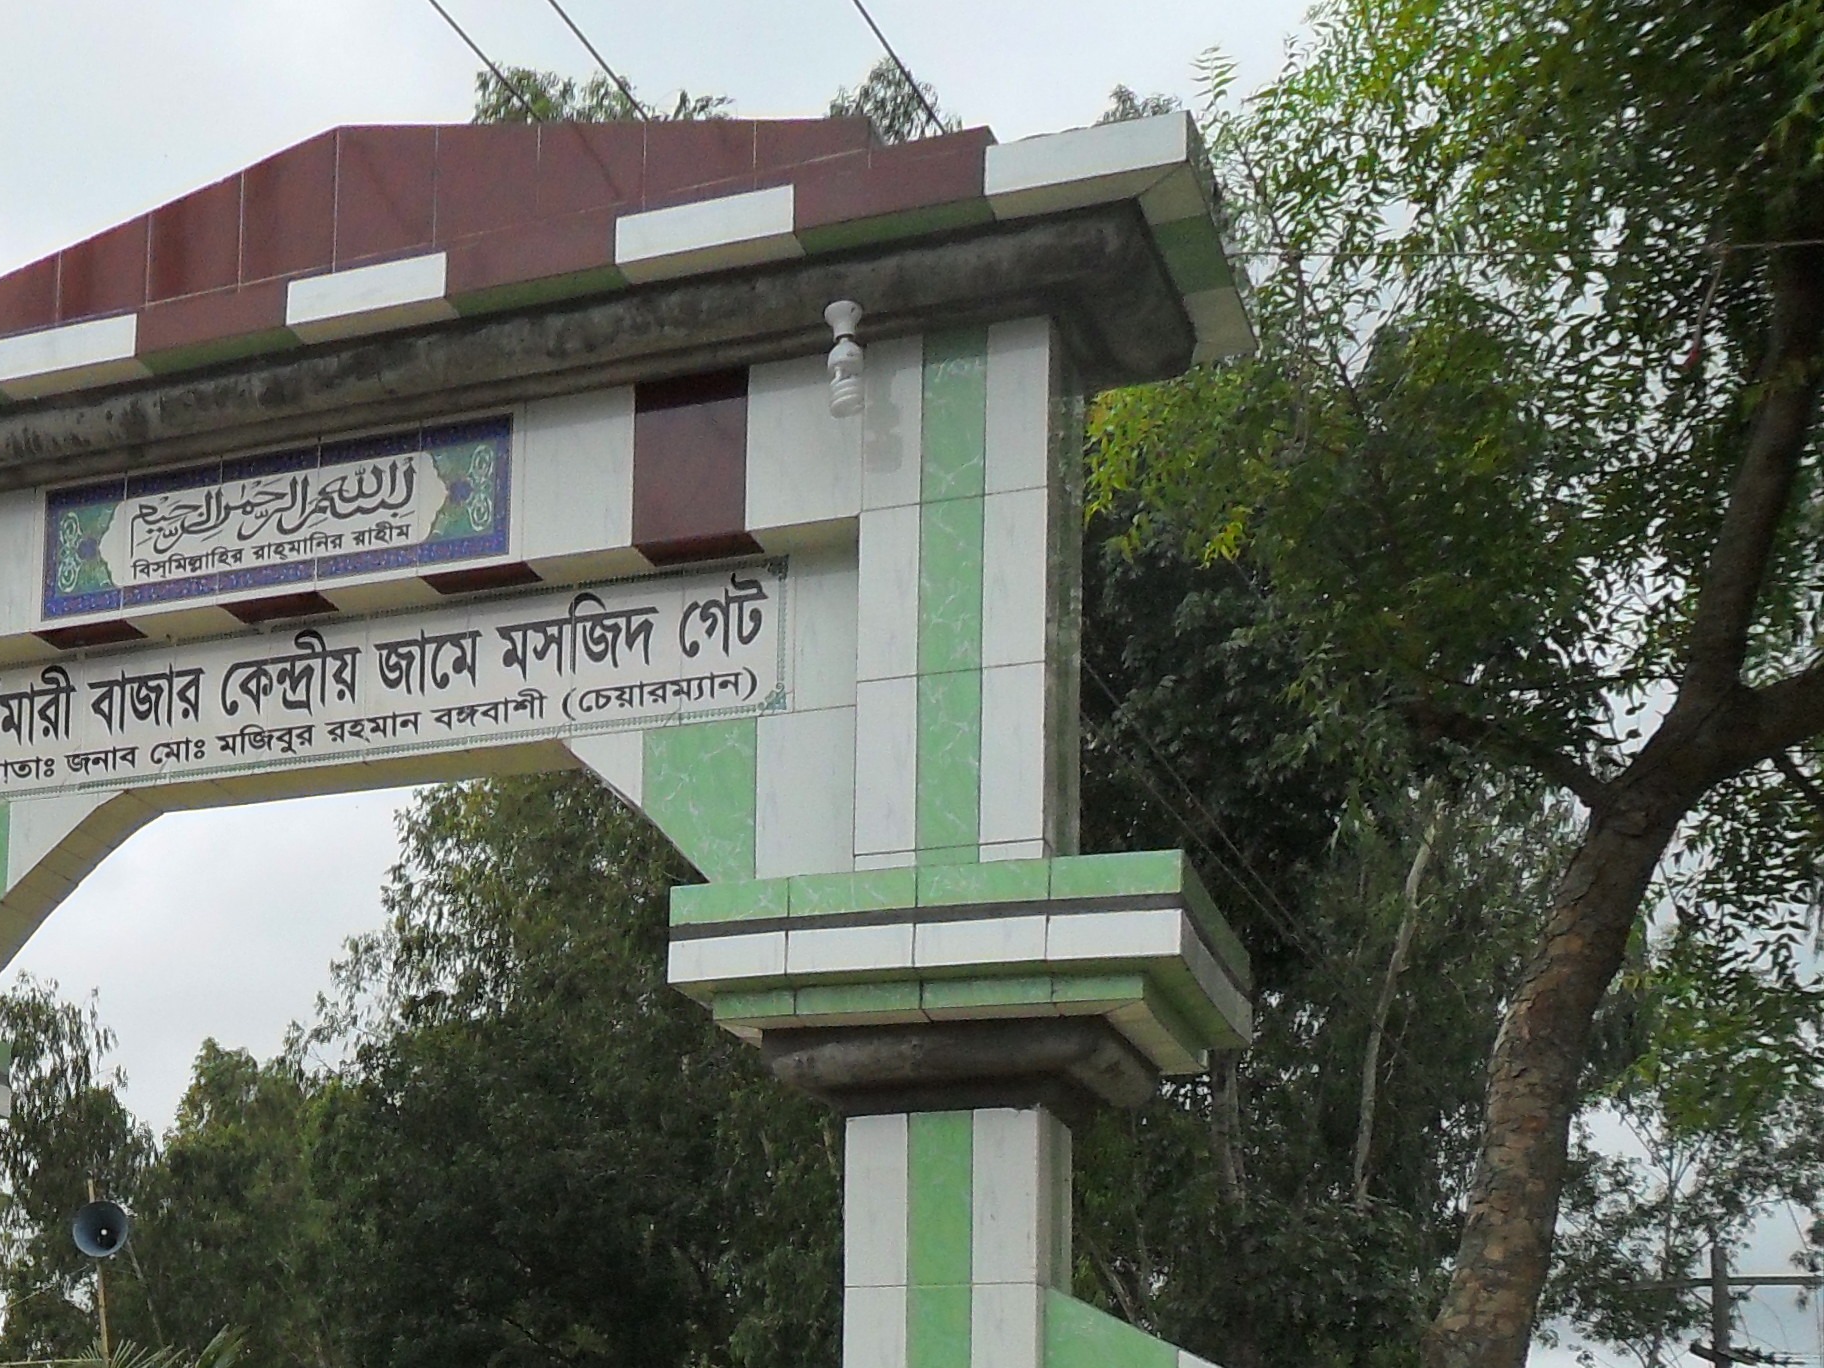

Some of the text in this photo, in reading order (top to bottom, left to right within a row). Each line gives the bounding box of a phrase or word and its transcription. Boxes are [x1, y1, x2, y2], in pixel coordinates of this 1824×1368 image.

[351, 520, 411, 546] রাহীম
[88, 663, 203, 737] বাজার
[222, 629, 362, 717] কেন্দ্রীয়
[374, 628, 482, 698] জামে
[497, 591, 659, 682] মসজিদ
[679, 572, 768, 658] গেট
[65, 746, 140, 776] জনাব
[150, 737, 206, 765] মোঃ
[215, 723, 315, 757] মজিবুর
[325, 711, 423, 743] রহমান
